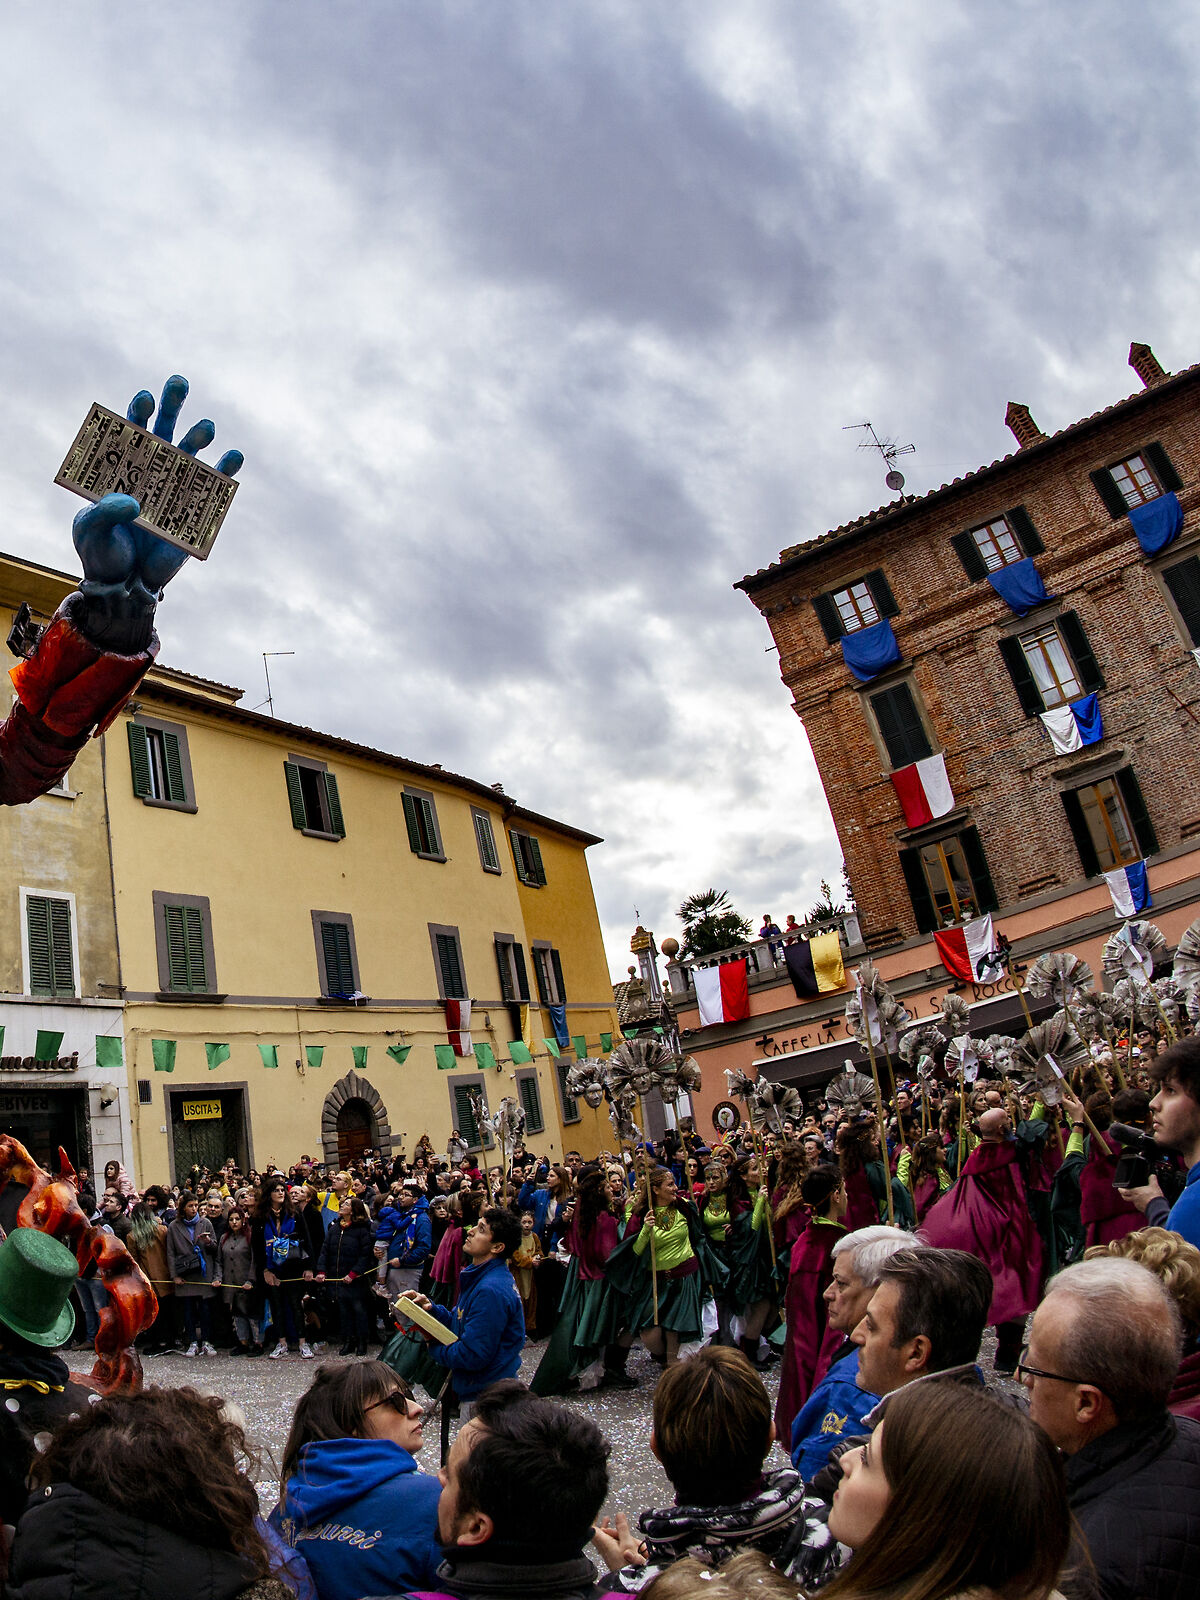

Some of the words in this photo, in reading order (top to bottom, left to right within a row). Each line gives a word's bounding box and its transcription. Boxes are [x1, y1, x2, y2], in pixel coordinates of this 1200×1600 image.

[817, 1029, 836, 1046] LA
[972, 974, 1025, 1003] ROCCO
[184, 1103, 213, 1116] USCITA
